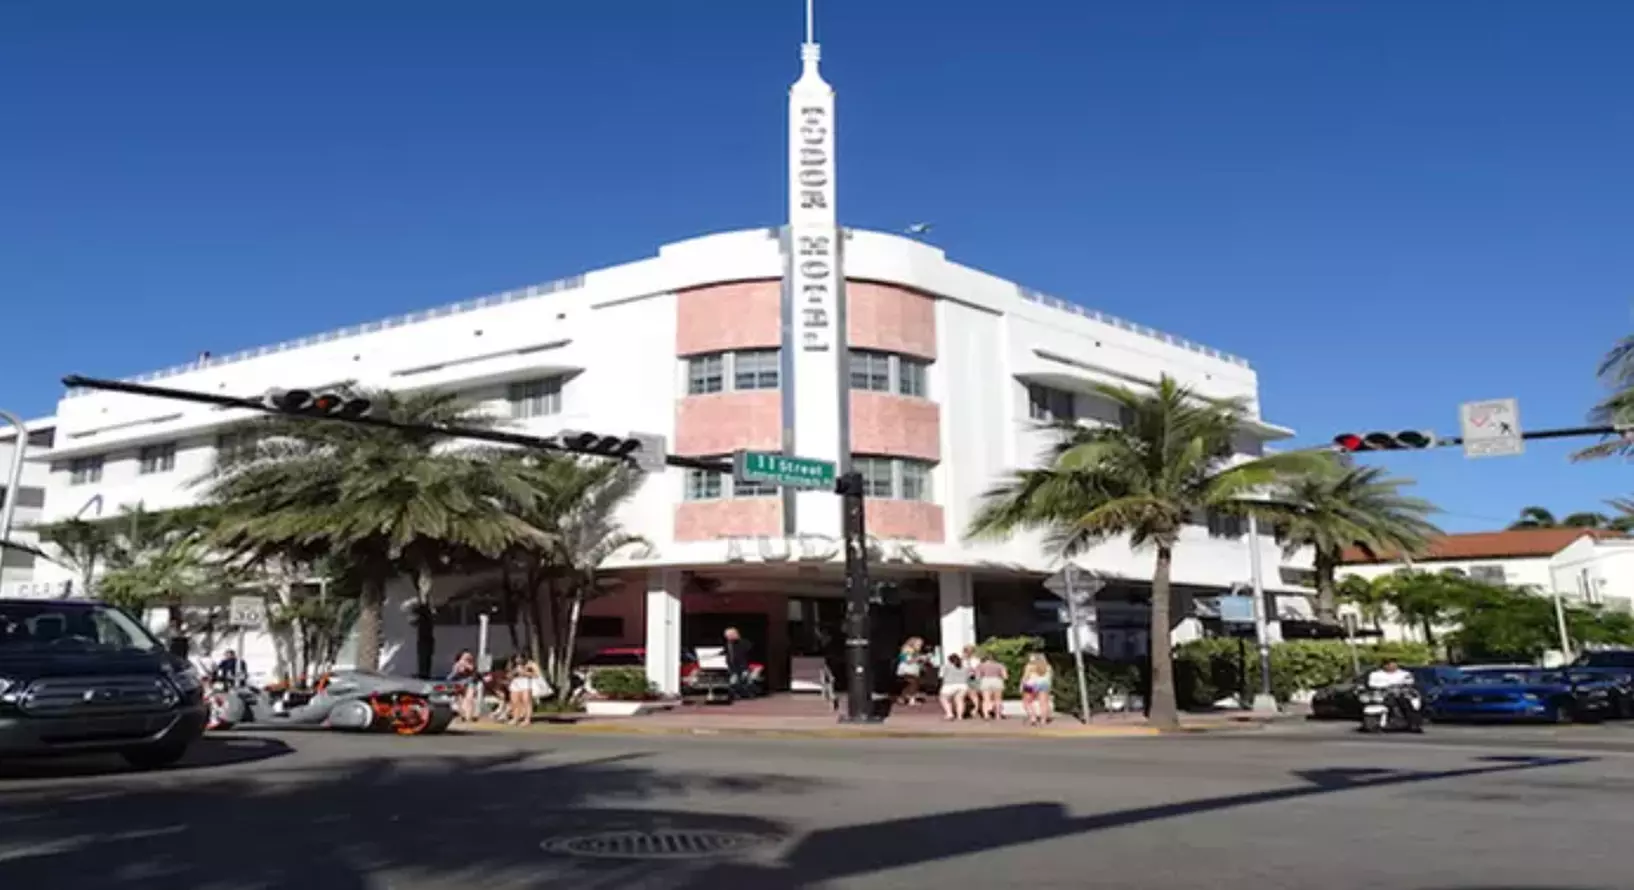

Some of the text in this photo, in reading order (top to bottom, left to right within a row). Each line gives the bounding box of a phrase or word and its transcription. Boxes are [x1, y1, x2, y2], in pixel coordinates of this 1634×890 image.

[799, 106, 830, 351] TUDOR HOTEL
[758, 454, 823, 477] 11 Street
